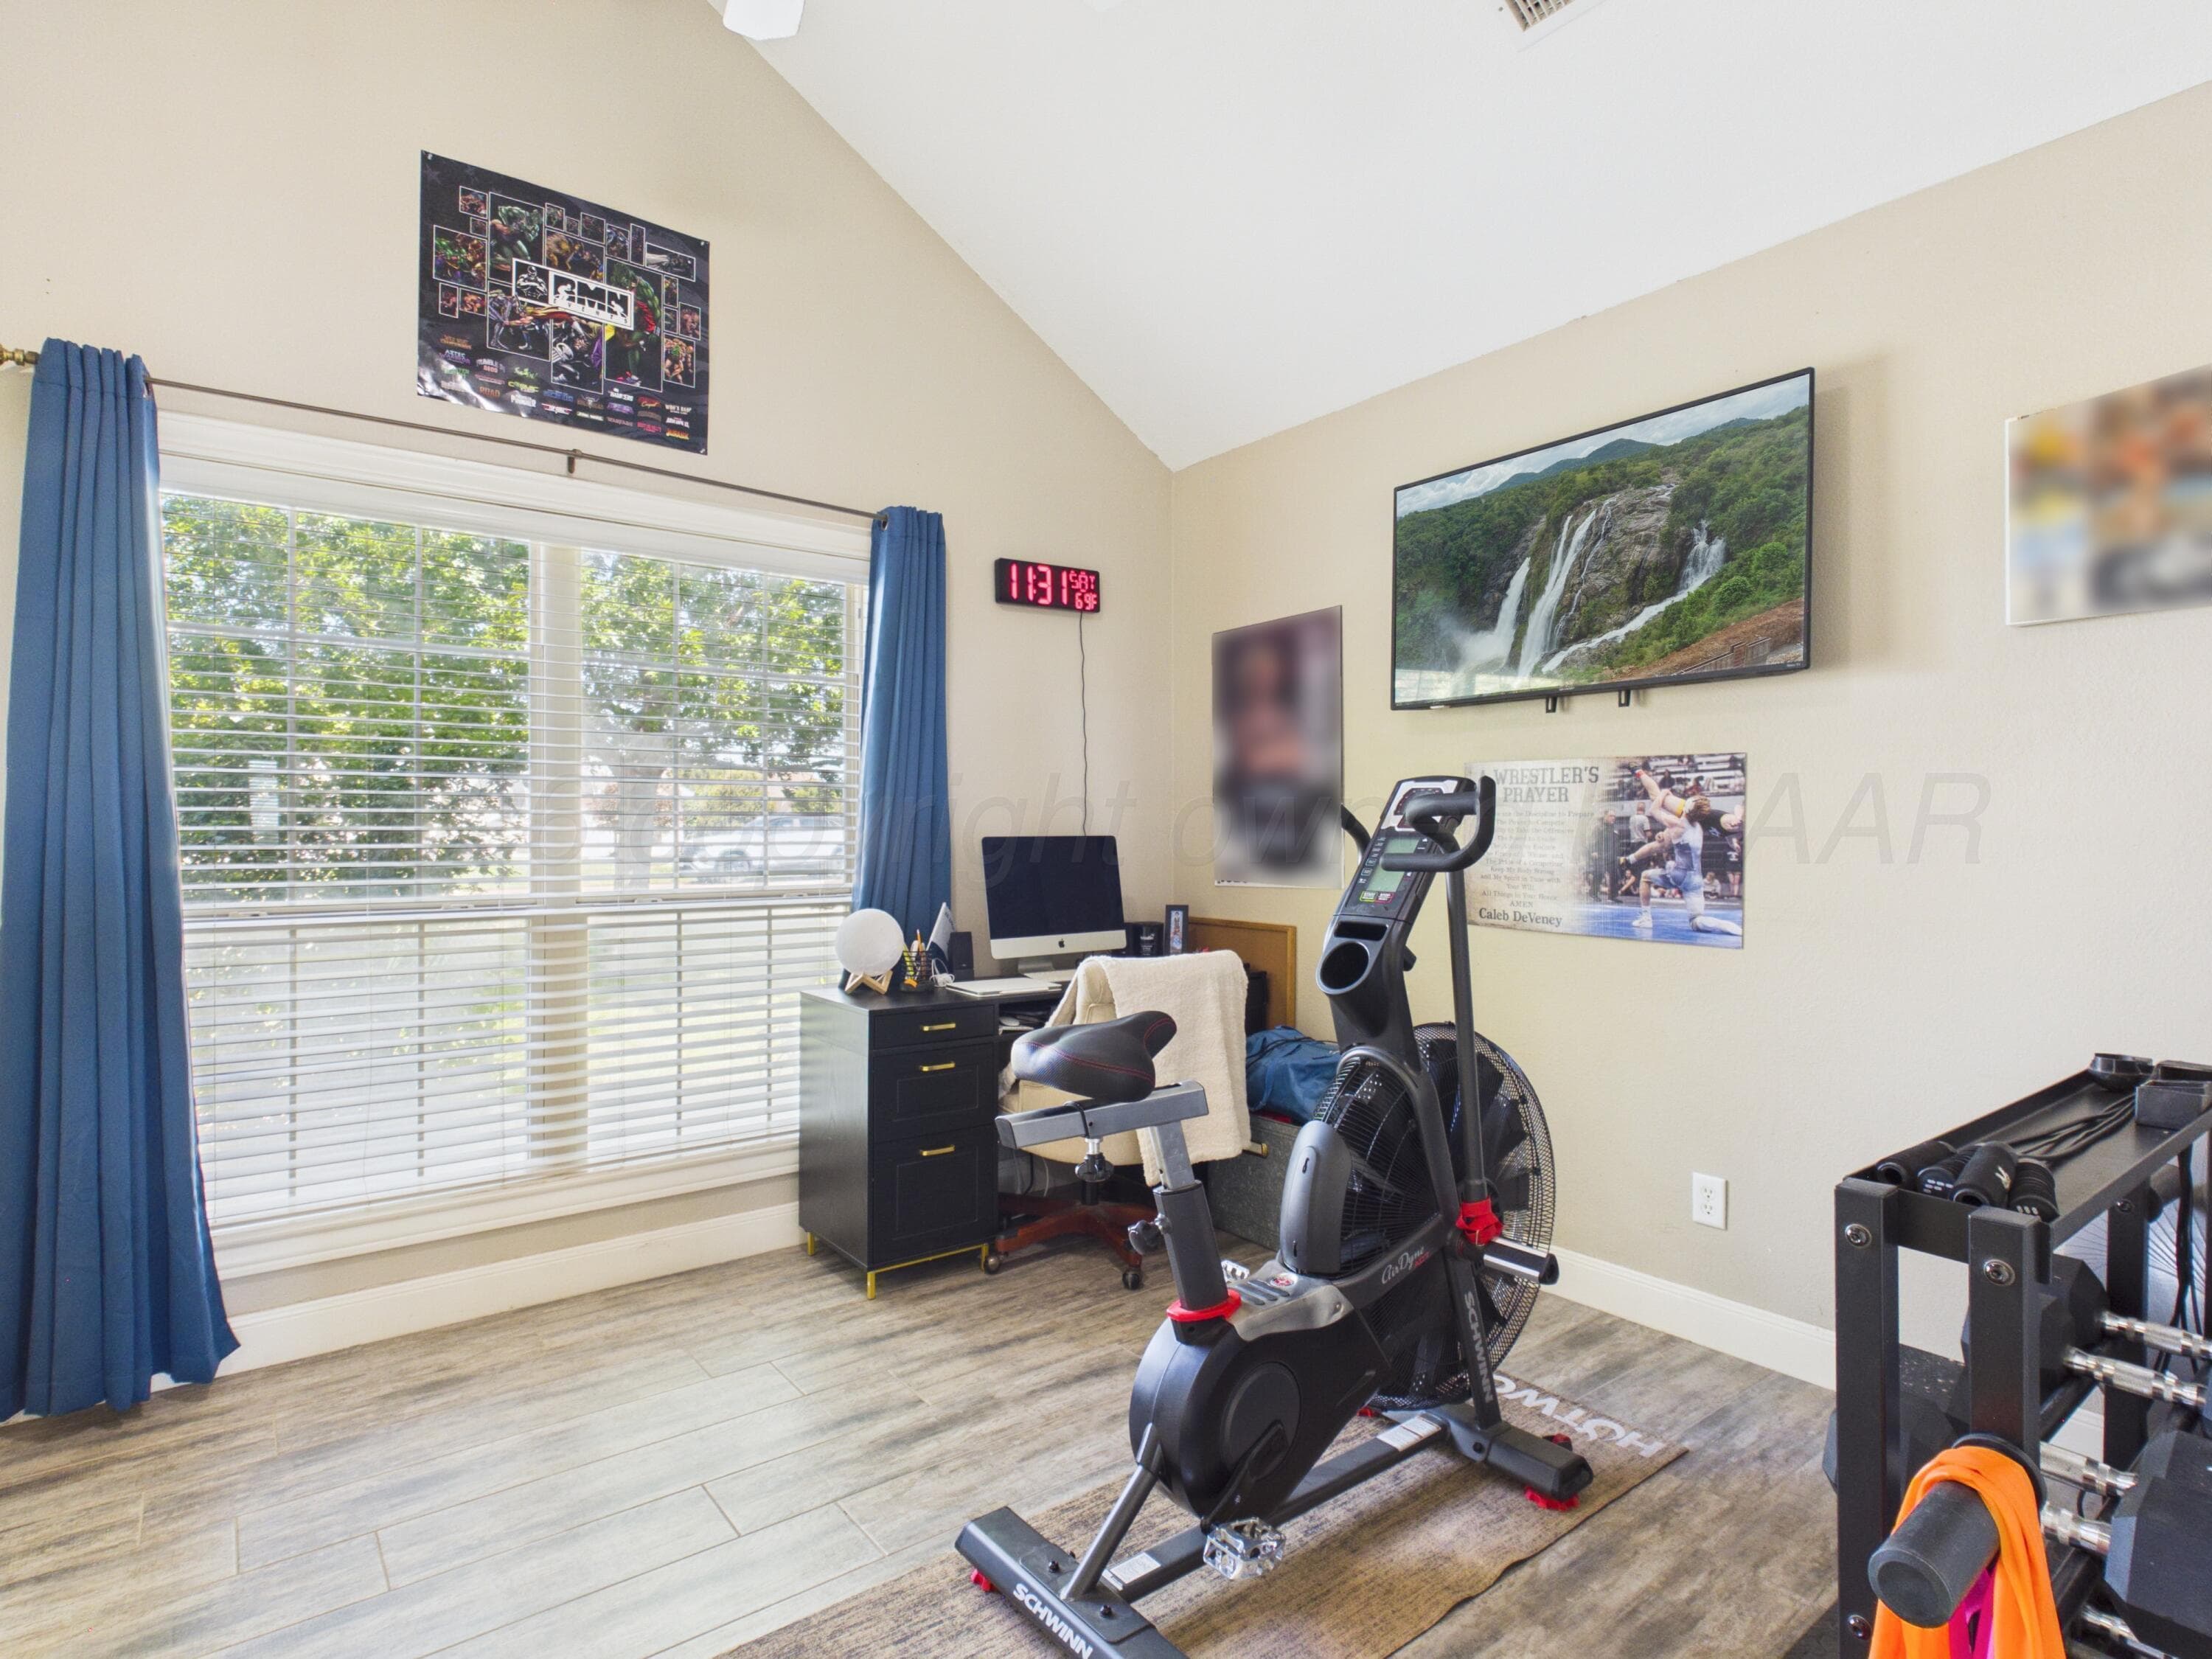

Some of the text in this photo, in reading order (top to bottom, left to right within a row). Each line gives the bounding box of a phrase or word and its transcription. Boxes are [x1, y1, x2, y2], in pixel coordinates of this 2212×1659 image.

[1011, 563, 1068, 605] 11:31
[1493, 767, 1599, 785] WRESTLER'S
[1503, 787, 1569, 802] PRAYER
[1479, 908, 1562, 928] Caleb DeVeney
[1381, 1246, 1425, 1284] AirDyne
[1464, 1291, 1494, 1403] SCHWINN
[1013, 1582, 1093, 1659] SCHWINN
